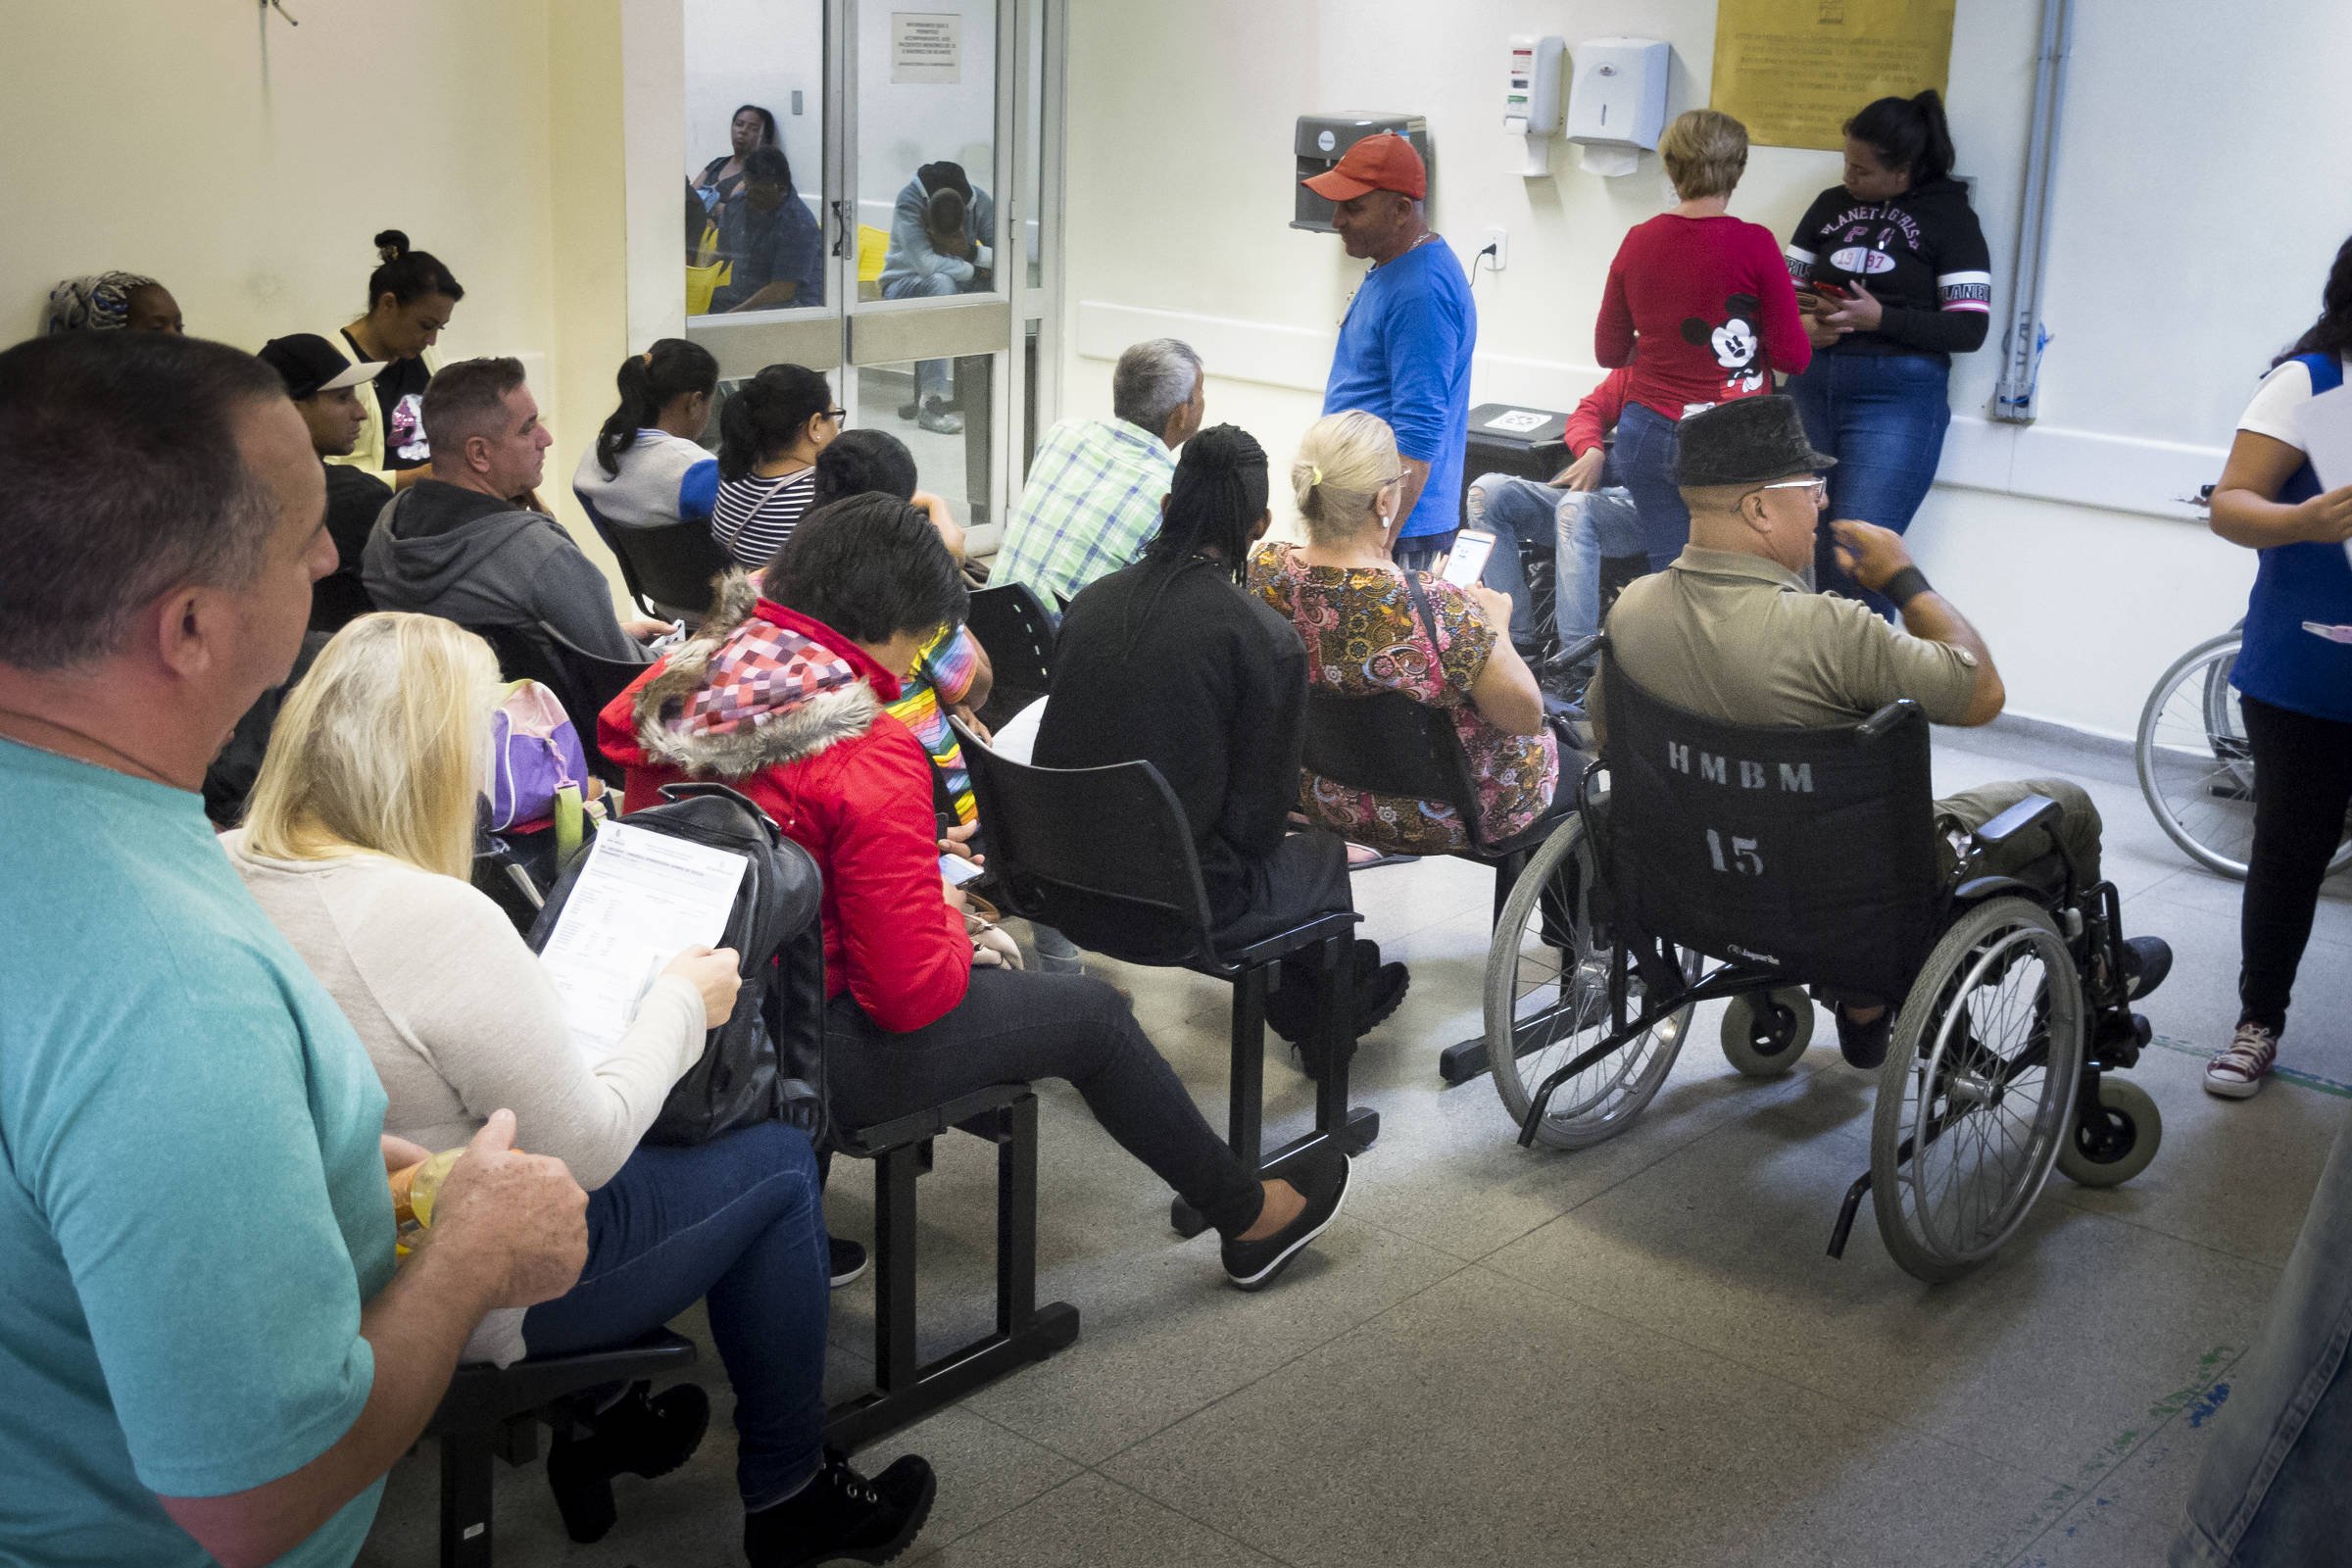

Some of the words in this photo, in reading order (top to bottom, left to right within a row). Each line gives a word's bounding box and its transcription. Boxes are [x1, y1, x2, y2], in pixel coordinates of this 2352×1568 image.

[1820, 207, 1880, 235] PLANET
[1938, 283, 1989, 302] LANET
[1669, 741, 1815, 793] HMBM
[1707, 828, 1764, 875] 15
